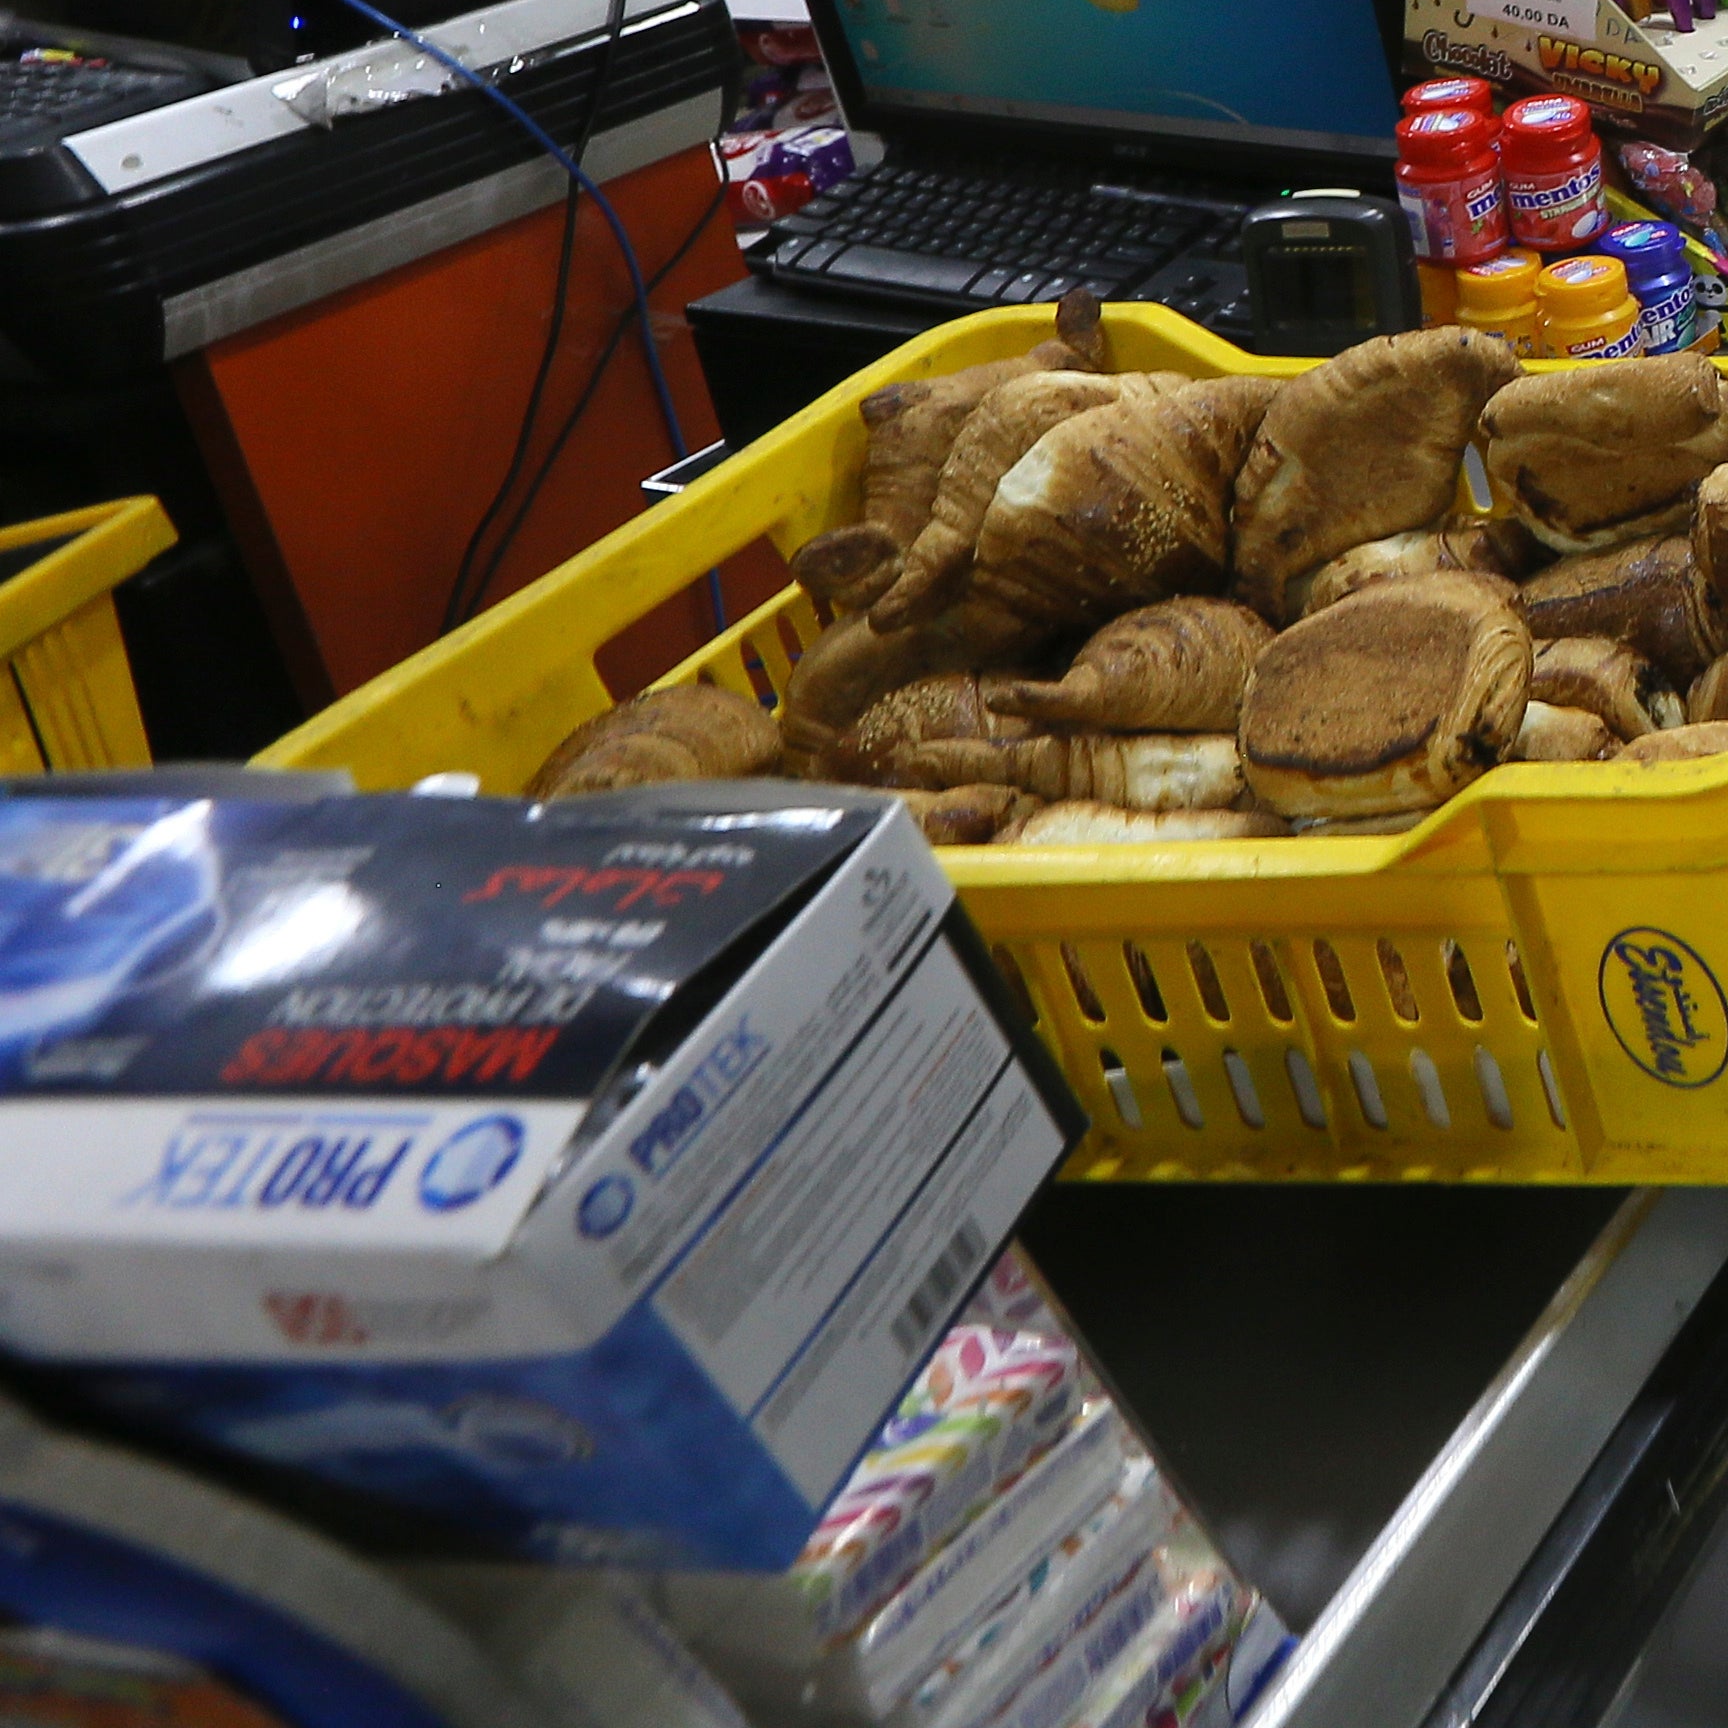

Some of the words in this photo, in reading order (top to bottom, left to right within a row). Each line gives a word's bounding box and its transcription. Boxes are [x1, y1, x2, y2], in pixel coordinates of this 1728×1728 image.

[1545, 10, 1570, 30] DA
[1422, 27, 1514, 81] Chocolat
[1537, 35, 1661, 95] VICKY
[1466, 179, 1494, 199] GUM
[1510, 164, 1601, 211] mentos
[1567, 337, 1606, 355] GUM
[631, 1016, 772, 1173] PROTEK
[128, 1131, 404, 1214] PROTEK
